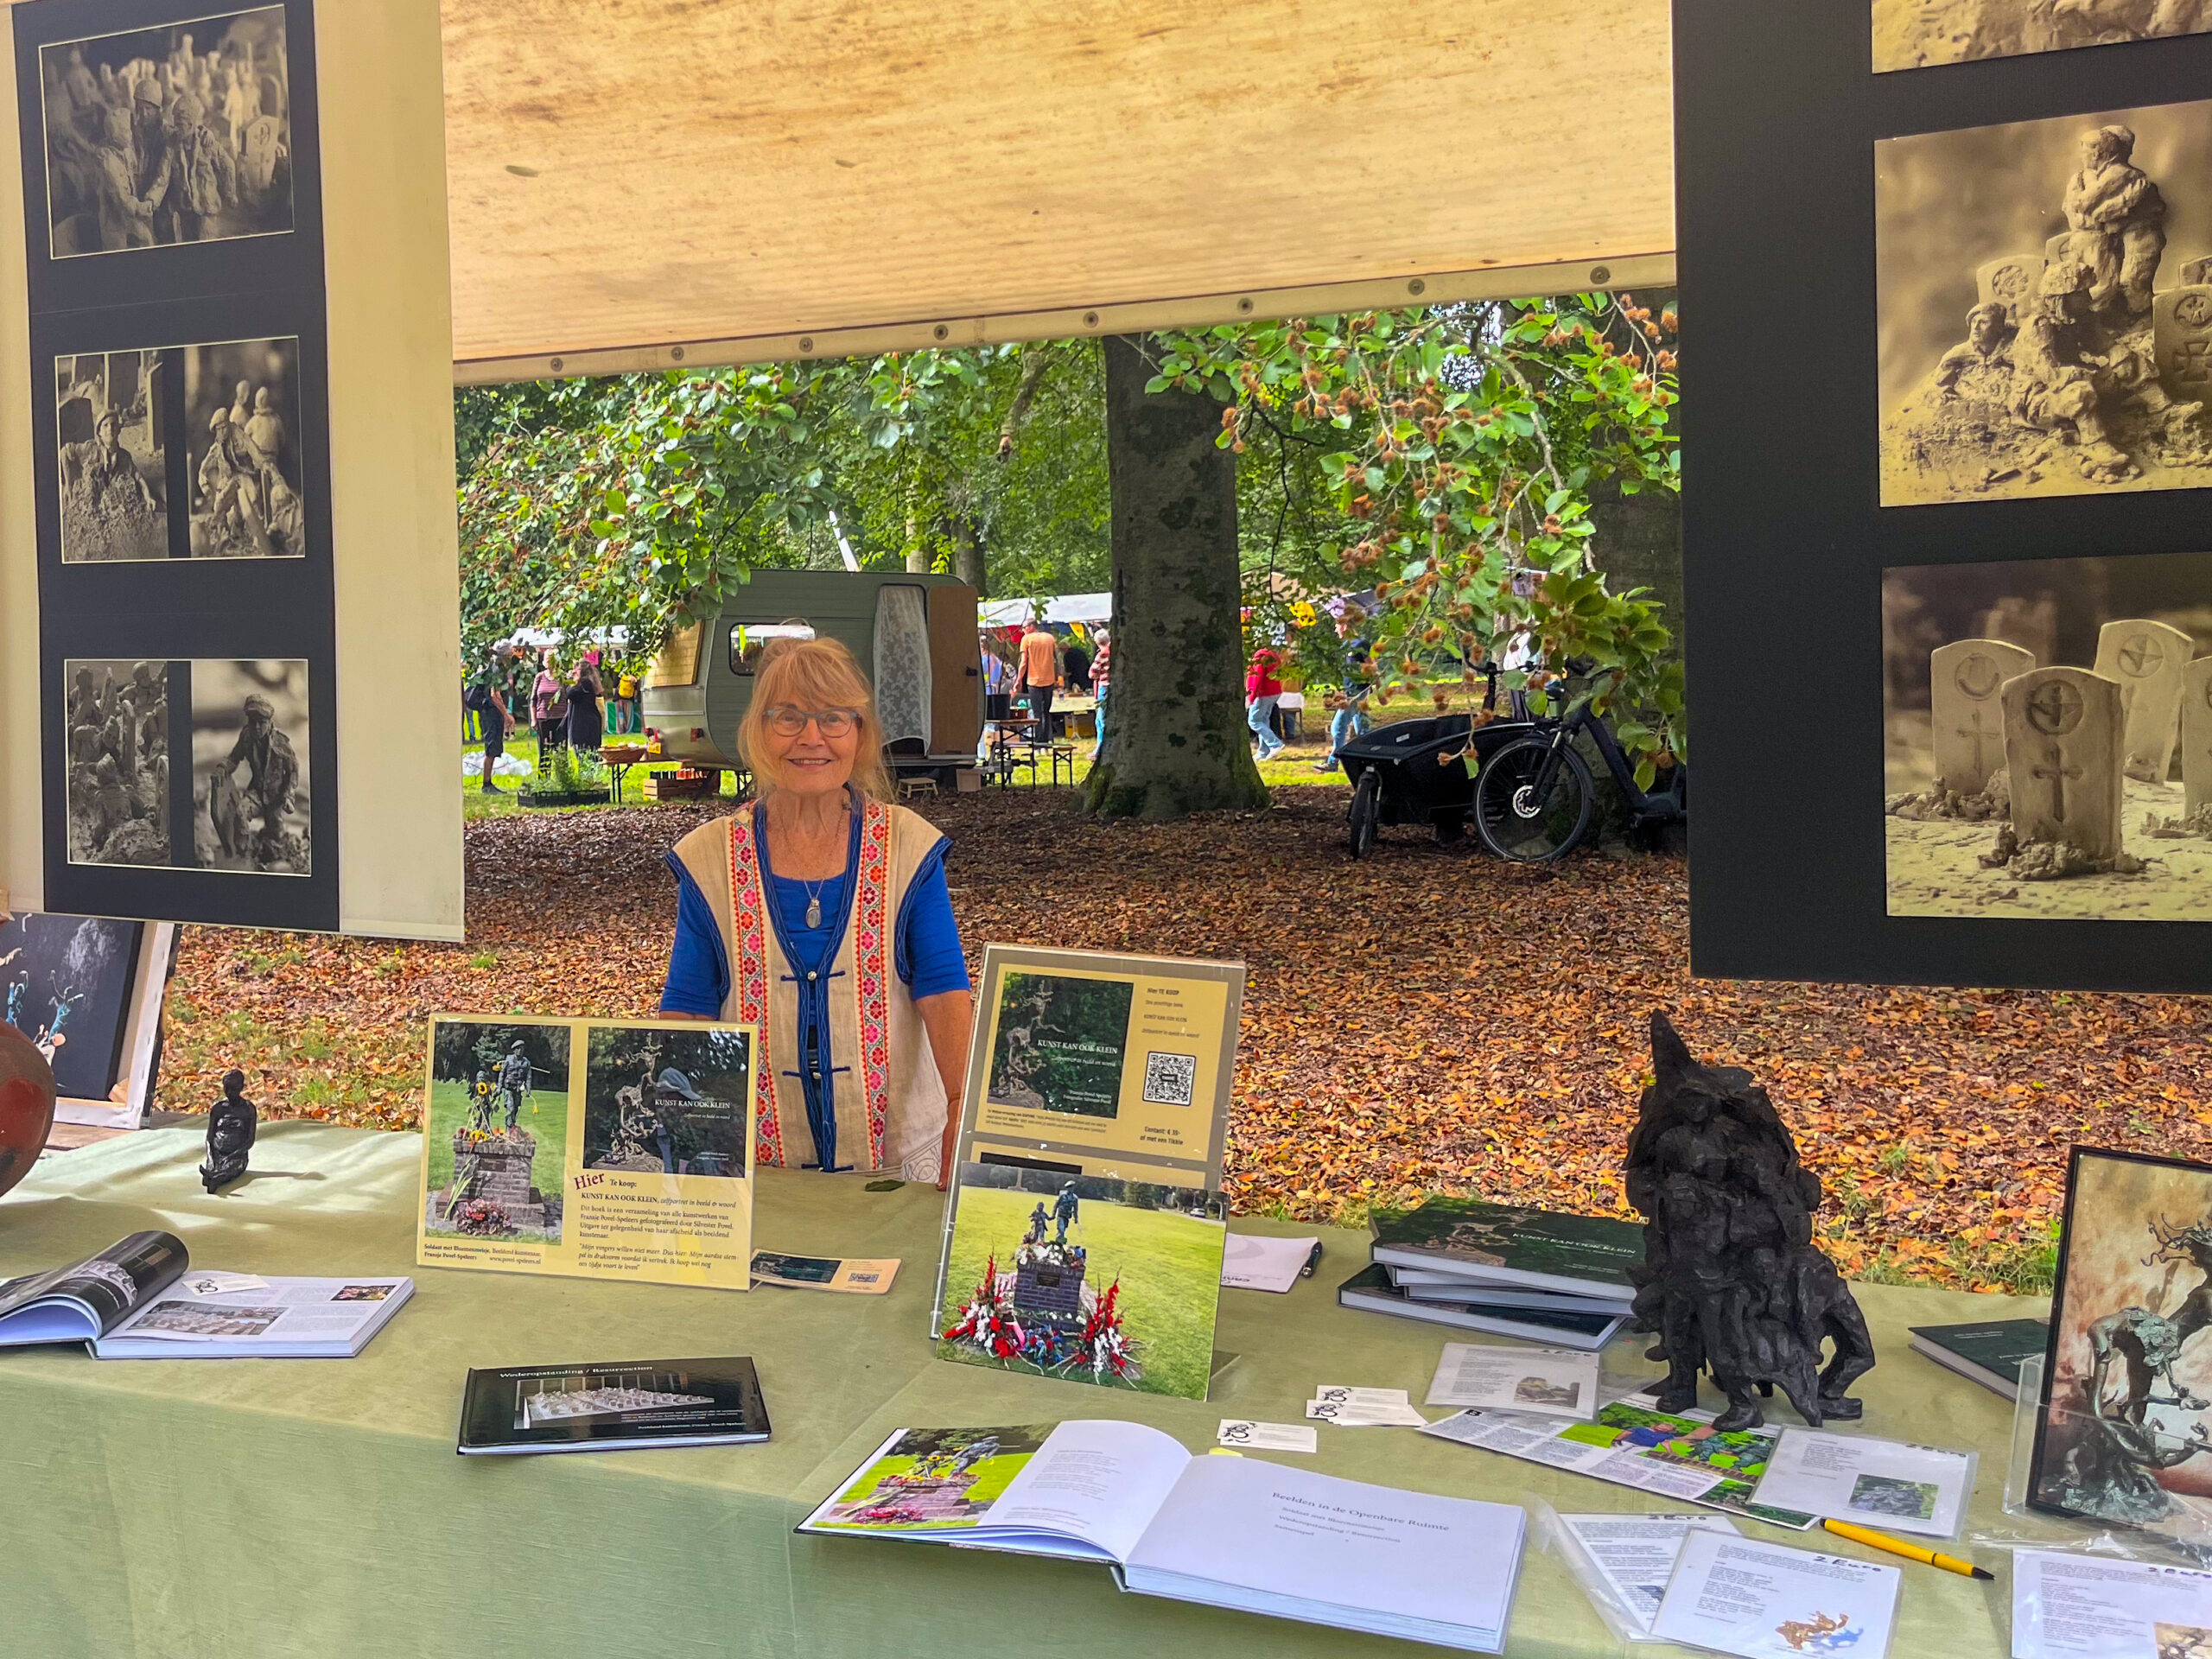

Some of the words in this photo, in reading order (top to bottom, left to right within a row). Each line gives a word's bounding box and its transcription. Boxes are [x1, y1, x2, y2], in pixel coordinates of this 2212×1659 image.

[1038, 1039, 1061, 1048] KUNST
[1078, 1044, 1095, 1052] OOK
[1096, 1046, 1118, 1054] KLEIN
[574, 1173, 605, 1191] Hier
[619, 1179, 637, 1188] koop:
[581, 1213, 600, 1222] Fransje
[639, 1217, 678, 1226] gefotografeerd
[683, 1211, 717, 1220] kunstwerken
[580, 1222, 600, 1230] Uitgave
[1513, 1233, 1548, 1242] KUNST
[1603, 1245, 1637, 1254] KLEIN
[677, 1259, 690, 1268] hoop
[500, 1369, 584, 1378] Wederopstanding
[1922, 1446, 1967, 1458] Euro
[1272, 1492, 1315, 1508] Beelden
[1349, 1510, 1405, 1524] Openbare
[1408, 1520, 1450, 1531] Ruimte
[1832, 1559, 1881, 1572] Euro
[2164, 1568, 2212, 1579] Euro
